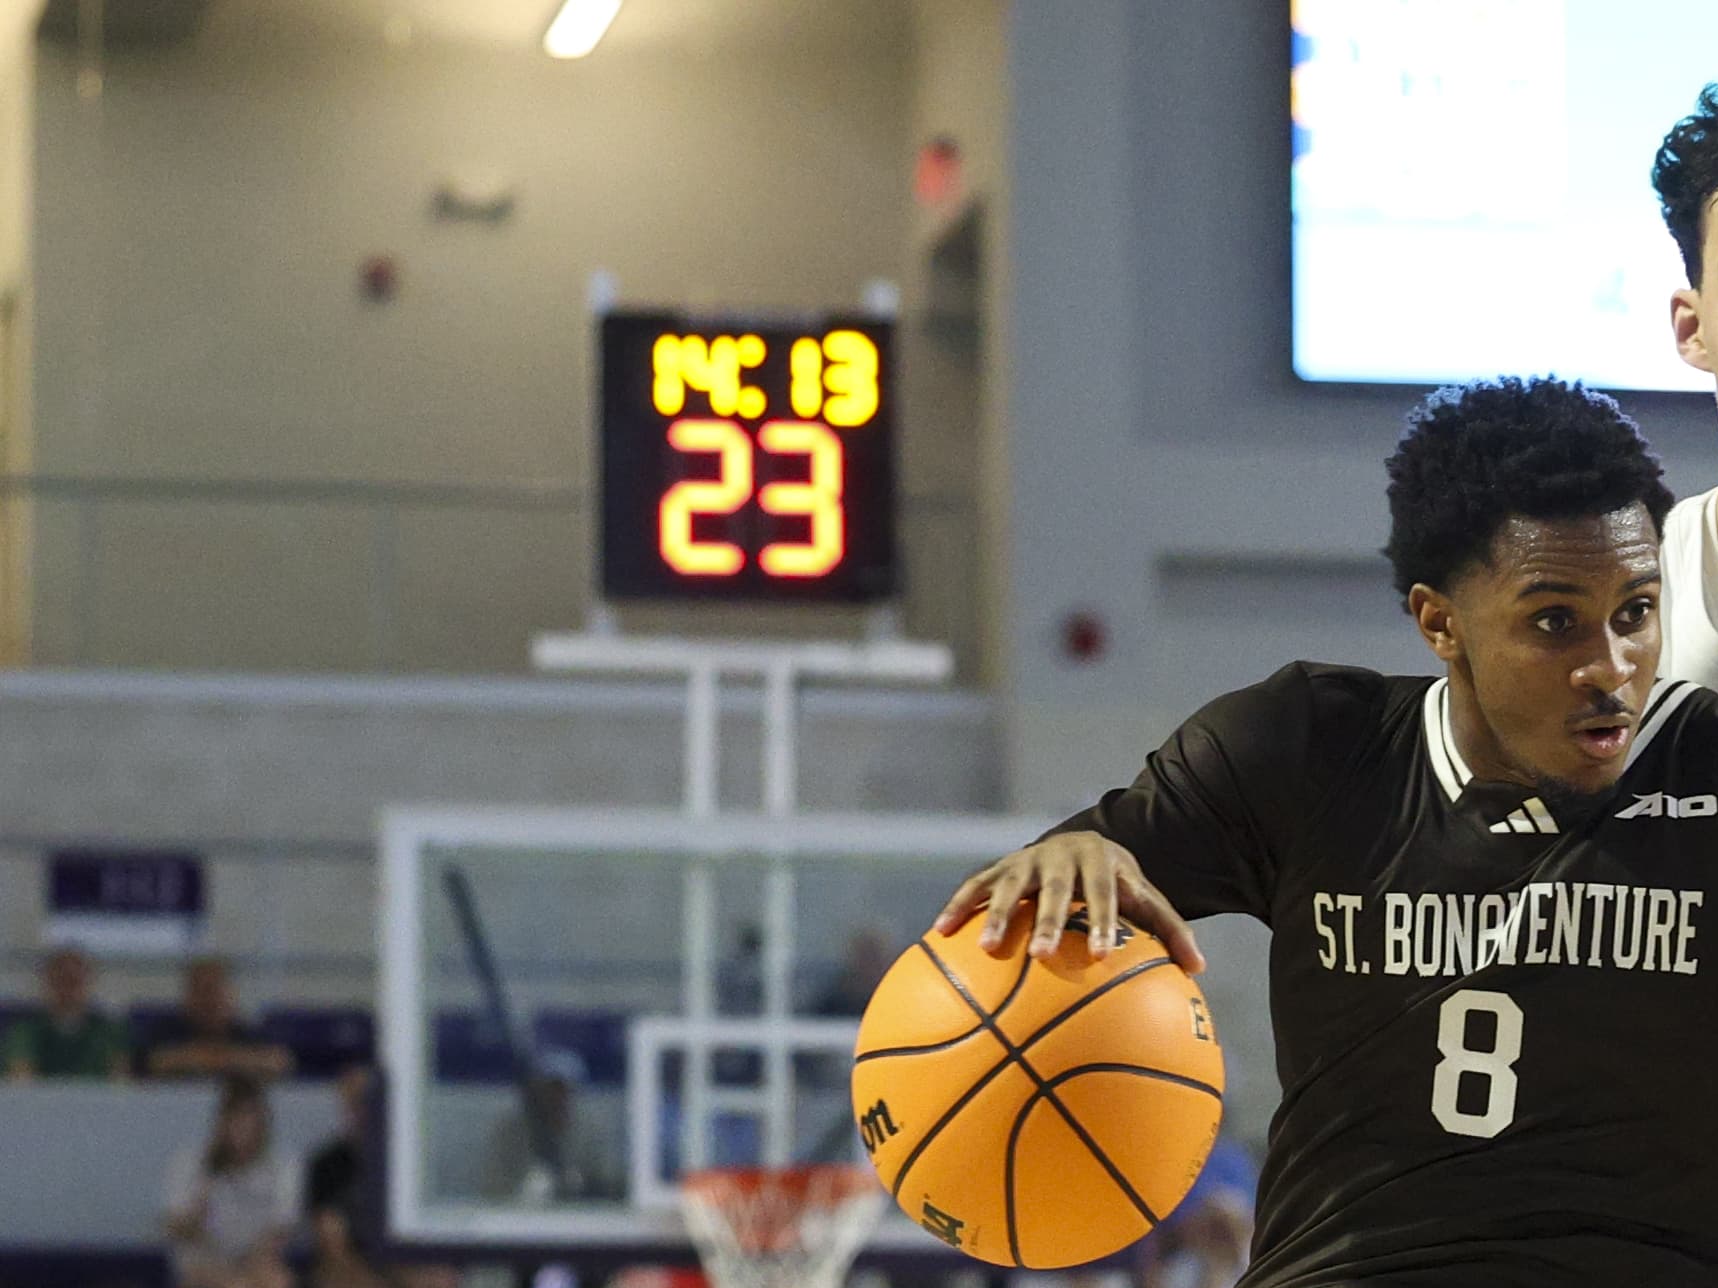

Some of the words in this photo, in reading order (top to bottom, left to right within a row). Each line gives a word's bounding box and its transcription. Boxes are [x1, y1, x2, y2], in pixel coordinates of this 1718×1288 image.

[659, 419, 844, 577] 23
[1313, 892, 1370, 975] ST.
[1384, 882, 1703, 977] BONAVENTURE
[1431, 989, 1524, 1139] 8
